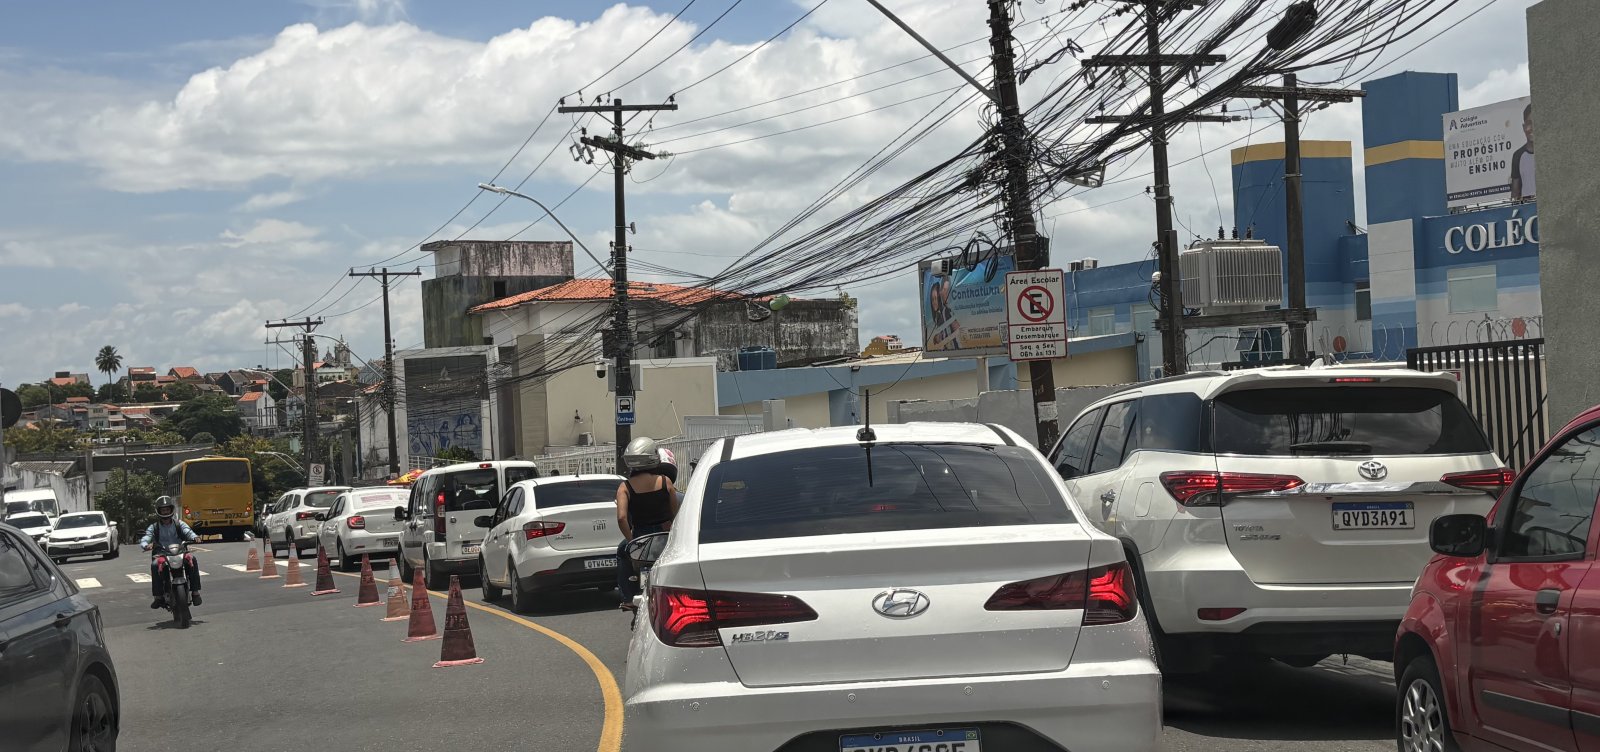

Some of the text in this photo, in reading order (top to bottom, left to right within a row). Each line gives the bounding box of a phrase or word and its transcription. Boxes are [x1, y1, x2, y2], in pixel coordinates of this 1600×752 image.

[1454, 140, 1512, 159] PROPÓSITO
[1469, 160, 1505, 174] ENSINO
[1010, 277, 1027, 285] Área
[1343, 511, 1407, 526] QYD3A91
